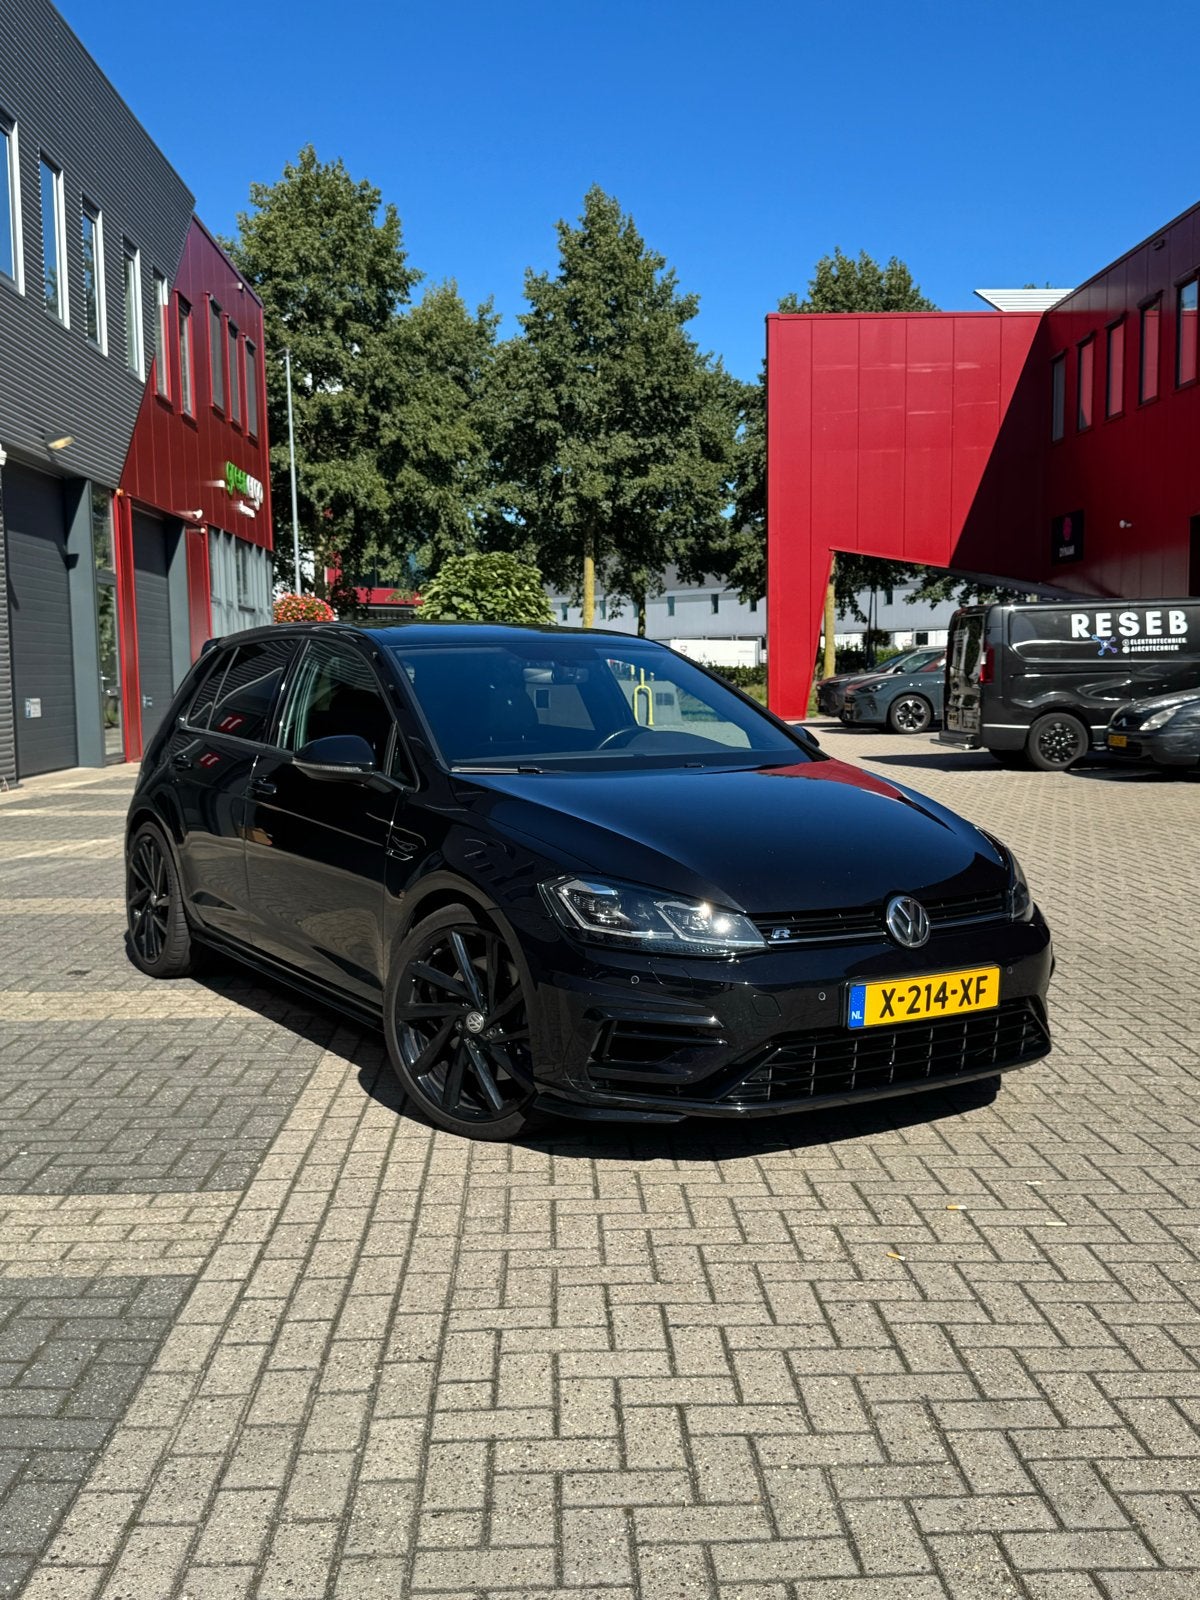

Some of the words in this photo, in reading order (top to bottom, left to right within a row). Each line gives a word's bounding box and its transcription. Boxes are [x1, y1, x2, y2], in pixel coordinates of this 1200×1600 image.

[1071, 610, 1188, 638] RESEB
[879, 975, 988, 1018] X-214-XF
[851, 1010, 863, 1020] NL
